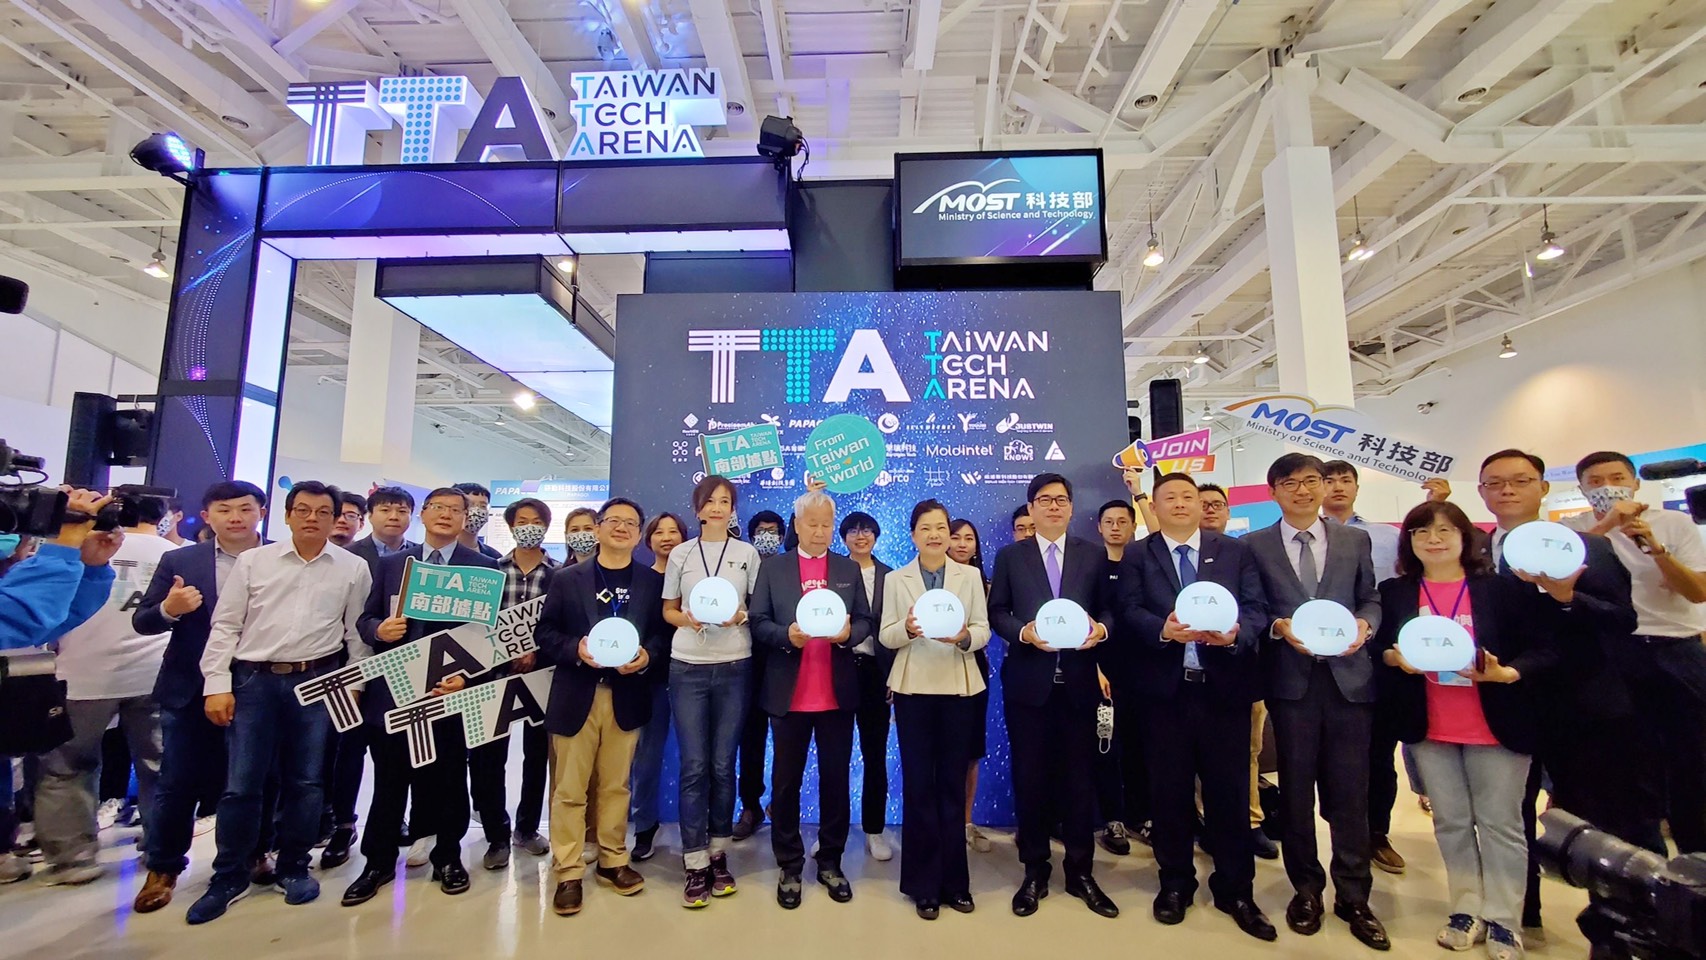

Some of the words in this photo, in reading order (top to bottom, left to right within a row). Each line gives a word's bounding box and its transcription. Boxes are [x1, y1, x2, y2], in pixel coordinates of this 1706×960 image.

[287, 76, 552, 165] TTA
[574, 101, 666, 127] TECH
[571, 129, 697, 156] ARENA
[938, 192, 1021, 213] MOST
[1025, 191, 1094, 210] 科技部
[938, 212, 974, 222] Ministry
[976, 211, 986, 220] of
[987, 211, 1021, 220] Science
[1023, 210, 1040, 219] and
[1042, 208, 1094, 220] Technology
[688, 329, 912, 403] TTA
[924, 354, 1007, 375] TECH
[923, 378, 1036, 400] ARENA
[1251, 402, 1356, 444] MOST
[709, 434, 751, 453] TTA
[814, 433, 845, 450] From
[926, 444, 994, 457] Moldintel
[1151, 437, 1207, 459] JOIN
[1246, 420, 1288, 440] Ministry
[1289, 435, 1303, 443] of
[1303, 438, 1345, 457] Science
[1346, 452, 1371, 464] and
[1373, 458, 1434, 482] Technolo
[713, 449, 778, 474] 南部據點
[808, 437, 870, 468] Taiwan
[1358, 433, 1454, 474] 科技部
[813, 470, 825, 479] to
[825, 462, 841, 474] the
[829, 456, 875, 484] world
[1171, 458, 1206, 473] US
[1541, 537, 1573, 553] TTA
[727, 560, 748, 572] TTA
[416, 566, 464, 592] TTA
[466, 587, 491, 596] ARENA
[698, 595, 719, 607] TTA
[1191, 595, 1218, 606] TTA
[409, 591, 493, 621] 南部據點
[811, 607, 834, 617] TTA
[933, 603, 956, 613] TTA
[1043, 615, 1067, 626] TTA
[1318, 626, 1346, 638] TTA
[1421, 636, 1454, 648] TTA
[493, 637, 534, 664] ARE
[598, 638, 620, 649] TTA
[298, 632, 487, 730] TTA
[388, 676, 547, 765] TTA
